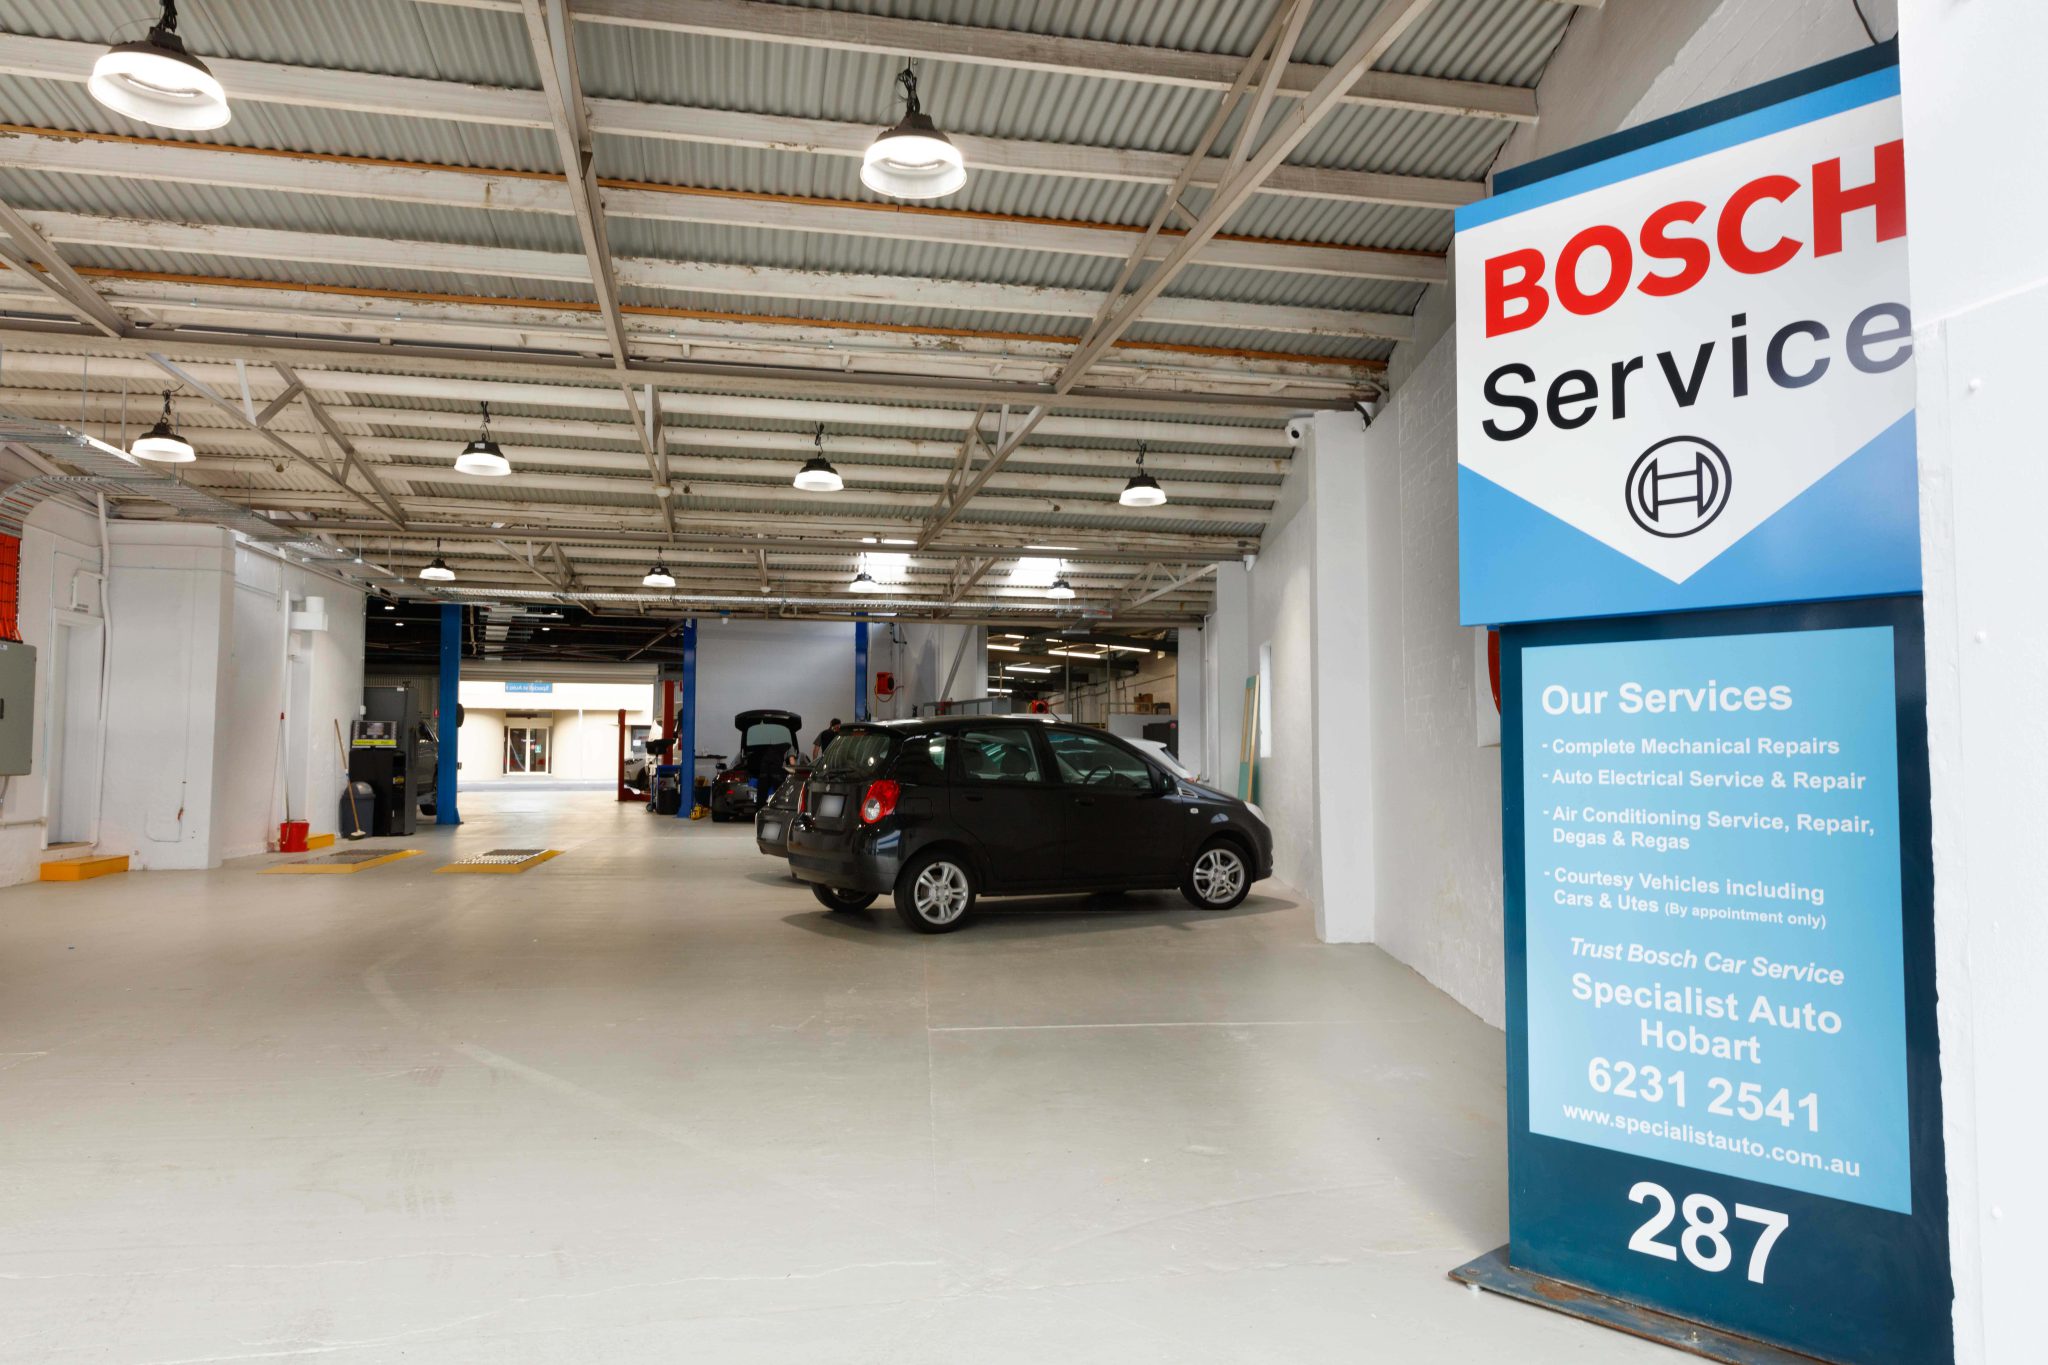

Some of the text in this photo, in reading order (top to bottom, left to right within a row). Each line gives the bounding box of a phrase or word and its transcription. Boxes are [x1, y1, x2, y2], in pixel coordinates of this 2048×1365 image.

[1485, 138, 1907, 339] BOSCH
[1481, 301, 1913, 442] Service
[1541, 679, 1793, 716] Our Services
[1552, 738, 1636, 757] Complete
[1641, 737, 1751, 754] Mechanical
[1757, 737, 1841, 758] Repairs
[1551, 769, 1593, 785] Auto
[1598, 769, 1683, 786] Electrical
[1689, 770, 1765, 788] Service
[1770, 770, 1787, 789] &
[1793, 771, 1867, 793] Repair
[1552, 805, 1578, 821] Air
[1582, 806, 1701, 831] Conditioning
[1707, 810, 1790, 833] Service,
[1796, 813, 1875, 837] Repair,
[1553, 827, 1690, 853] Degas & Regas
[1553, 889, 1827, 930] Cars & Utes (By appointment only)
[1554, 867, 1634, 892] Courtesy
[1639, 873, 1720, 894] Vehicles
[1726, 878, 1825, 906] including
[1570, 937, 1845, 986] Trust Bosch Car Service
[1572, 972, 1842, 1035] Specialist Auto
[1640, 1018, 1761, 1065] Hobart
[1588, 1056, 1819, 1133] 6231 2541
[1563, 1103, 1860, 1178] www.specialistauto.com.au
[1627, 1180, 1790, 1285] 287
